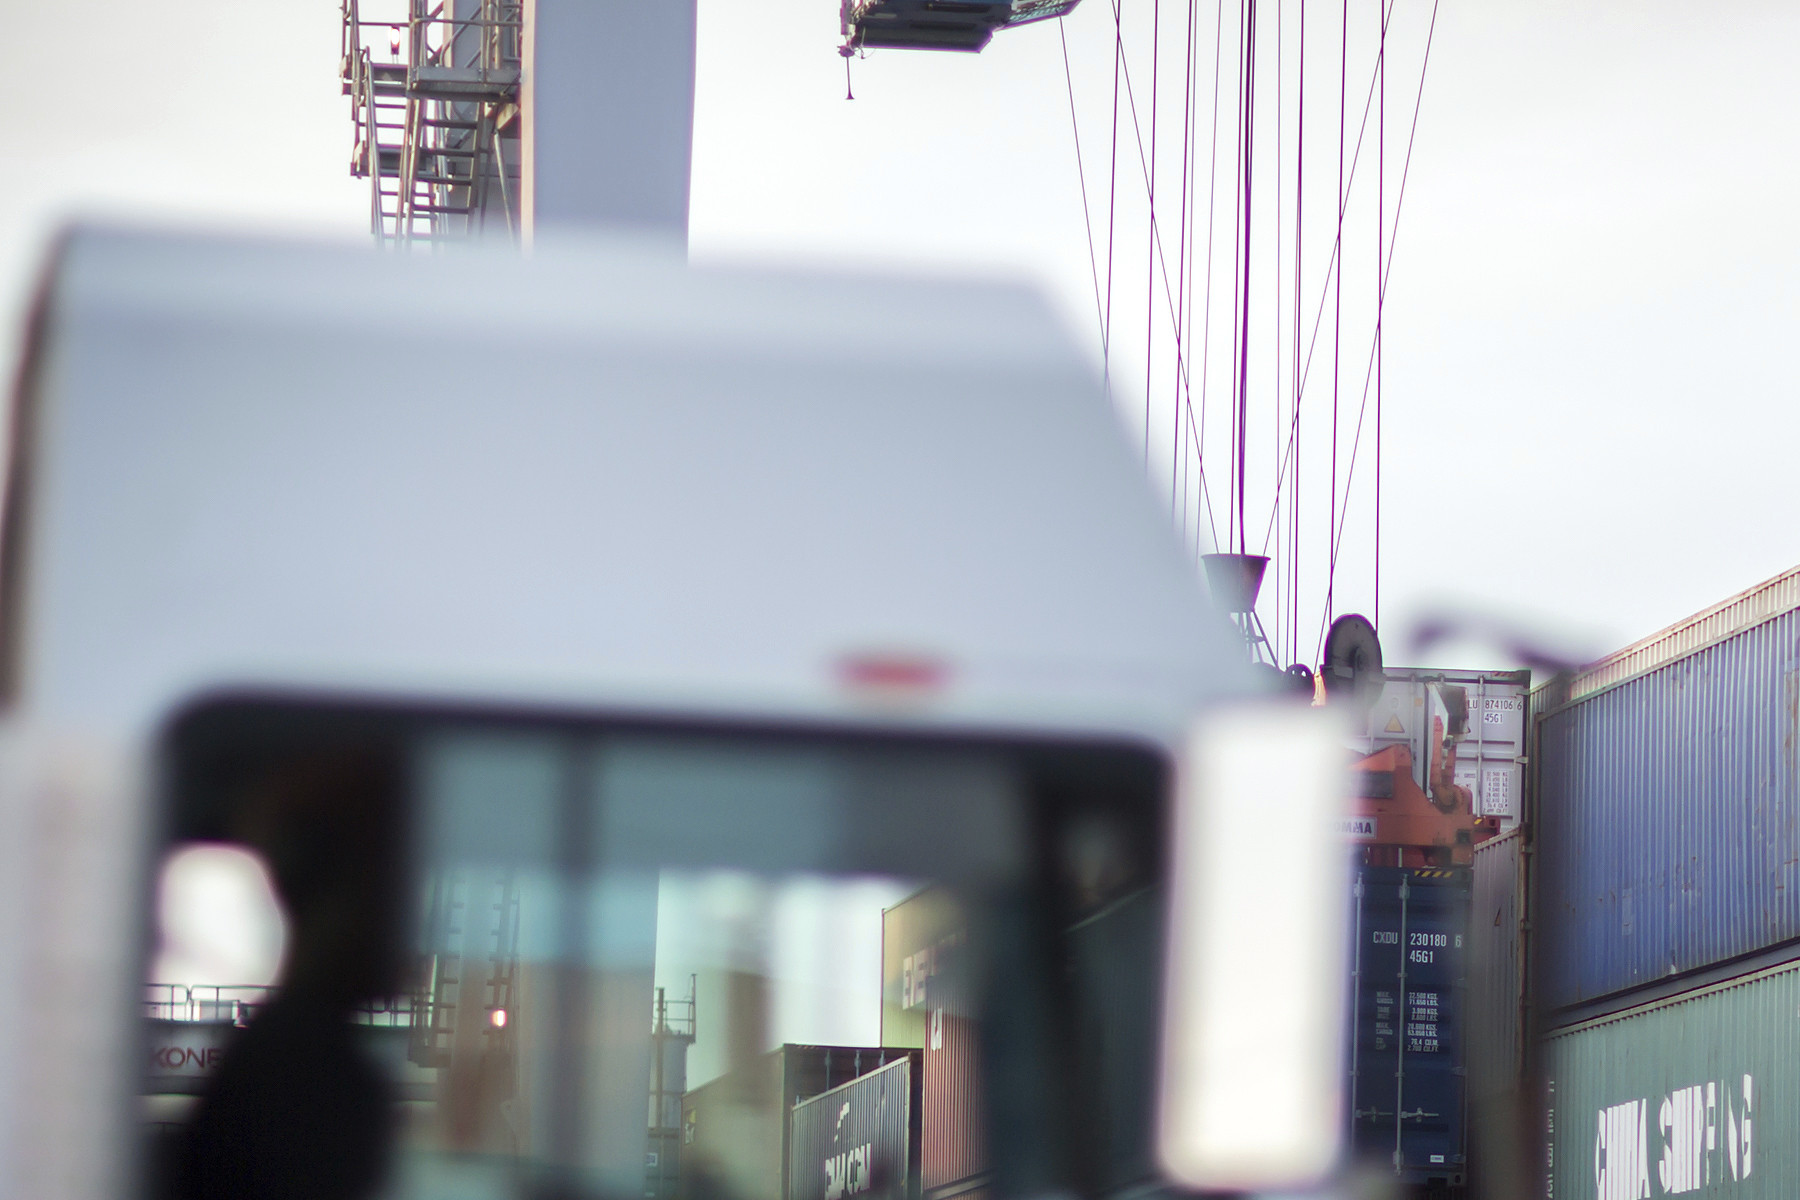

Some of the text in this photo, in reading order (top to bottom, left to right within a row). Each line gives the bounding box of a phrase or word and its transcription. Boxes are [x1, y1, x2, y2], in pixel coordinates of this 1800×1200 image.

[1485, 700, 1513, 710] 874106
[1485, 714, 1503, 723] 45G1
[1373, 931, 1399, 944] CXDU
[1410, 933, 1447, 947] 230180
[1410, 950, 1433, 963] 45G1
